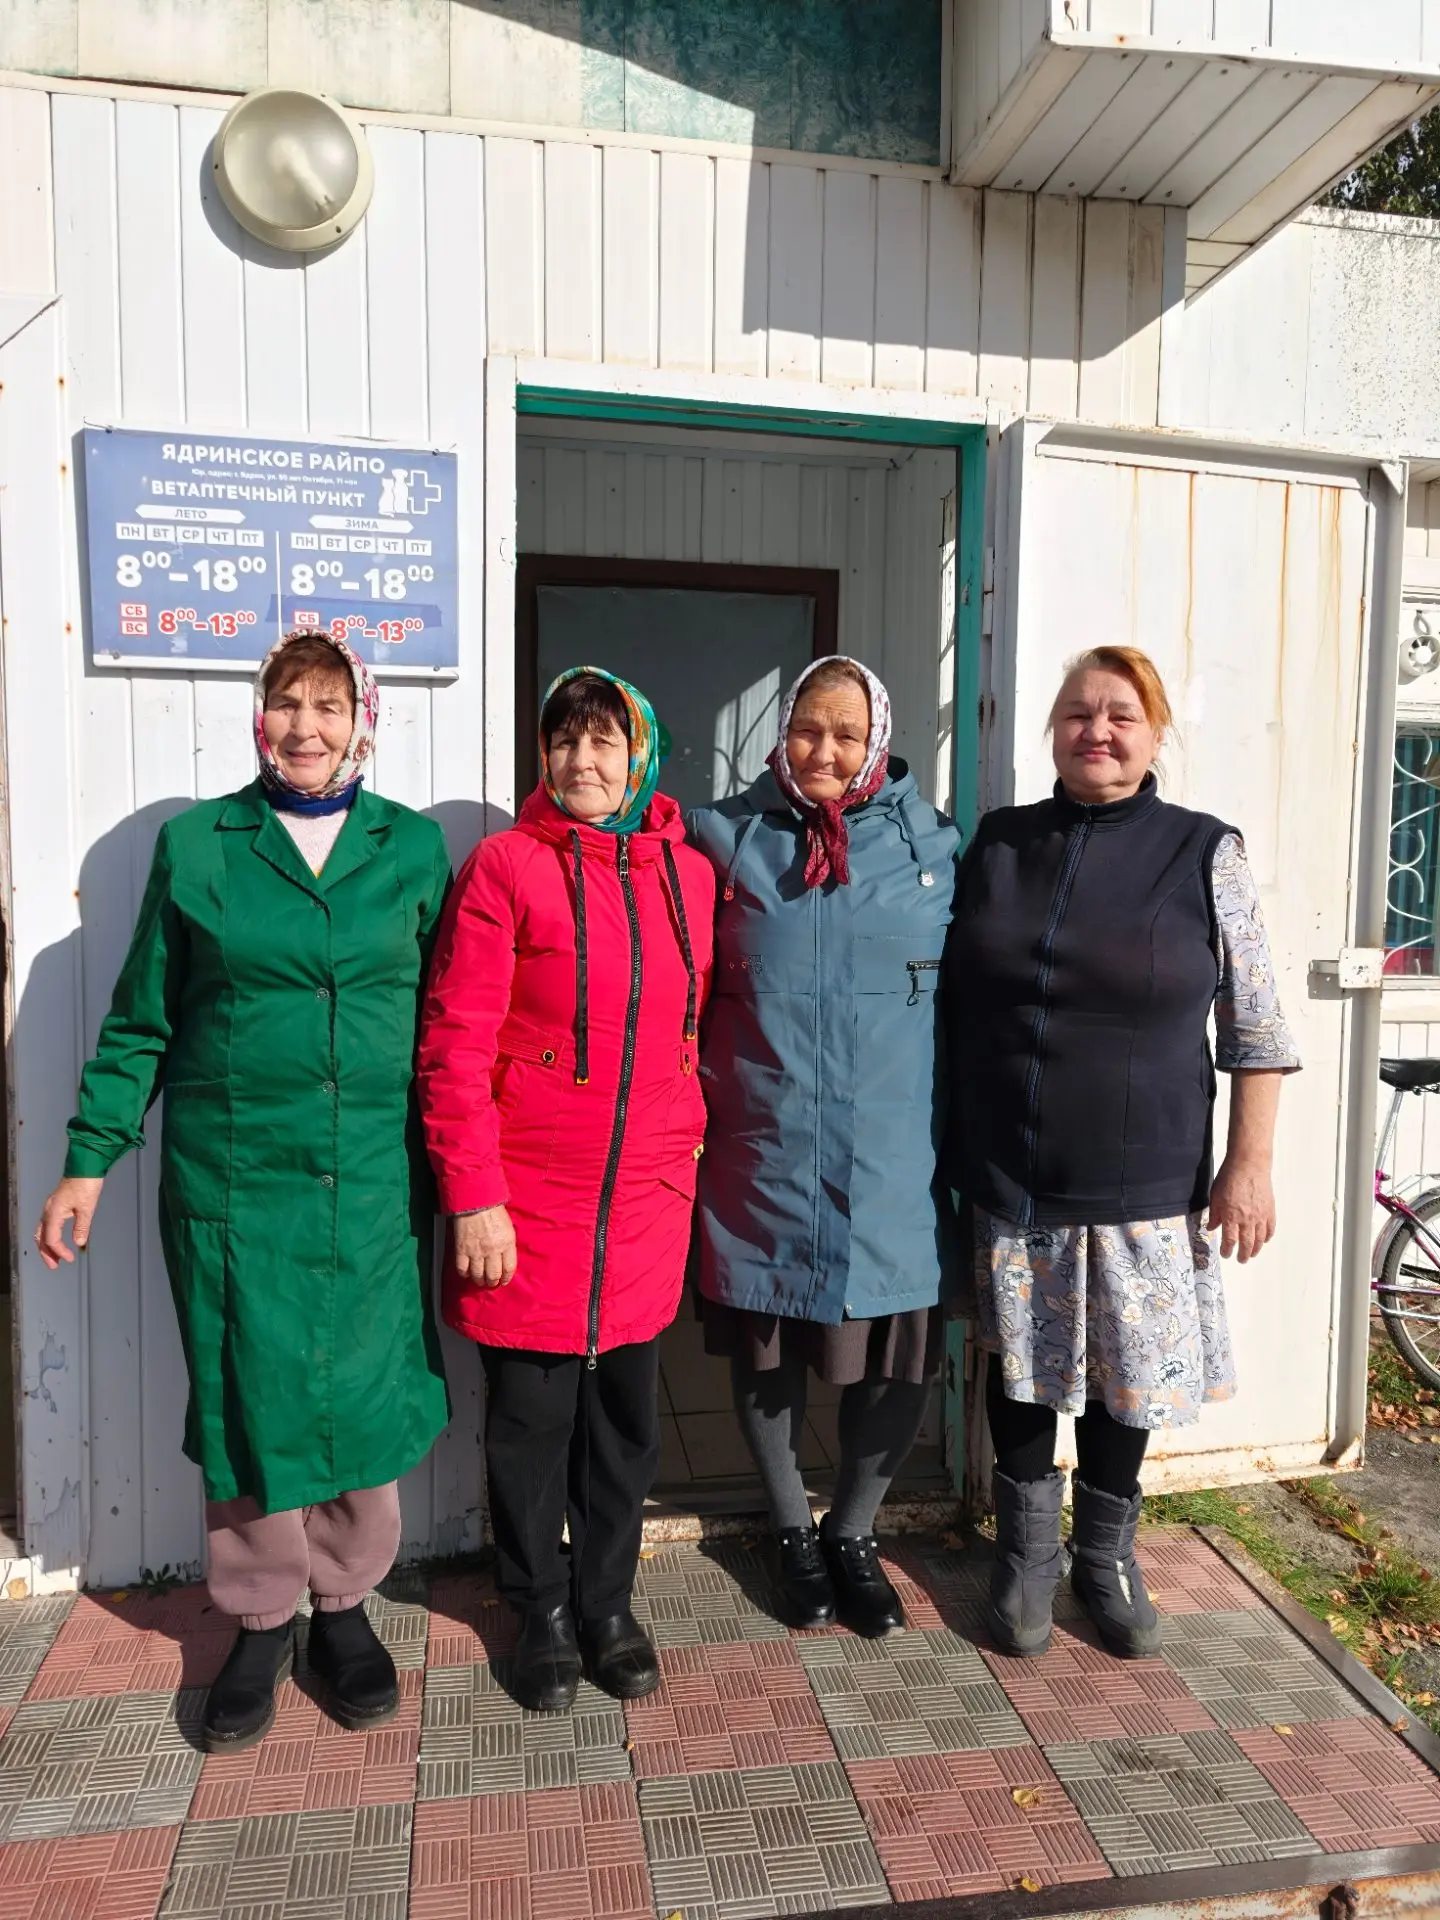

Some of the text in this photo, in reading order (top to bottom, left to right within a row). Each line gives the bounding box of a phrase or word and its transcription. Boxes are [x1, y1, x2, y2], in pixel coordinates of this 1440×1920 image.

[162, 443, 385, 474] ЯДРИНСКОЕ РАЙПО
[151, 479, 366, 508] ВЕТАПТЕЧНЫЙ ПУНКТ
[174, 508, 208, 520] ЛЕТО
[345, 518, 380, 530] ЗИМА
[121, 526, 259, 544] ПН ВТ СР ЧТ ПТ
[295, 536, 427, 553] ПН ВТ СР ЧТ ПТ
[125, 606, 143, 615] СБ
[298, 613, 316, 624] СБ
[126, 623, 144, 633] ВС
